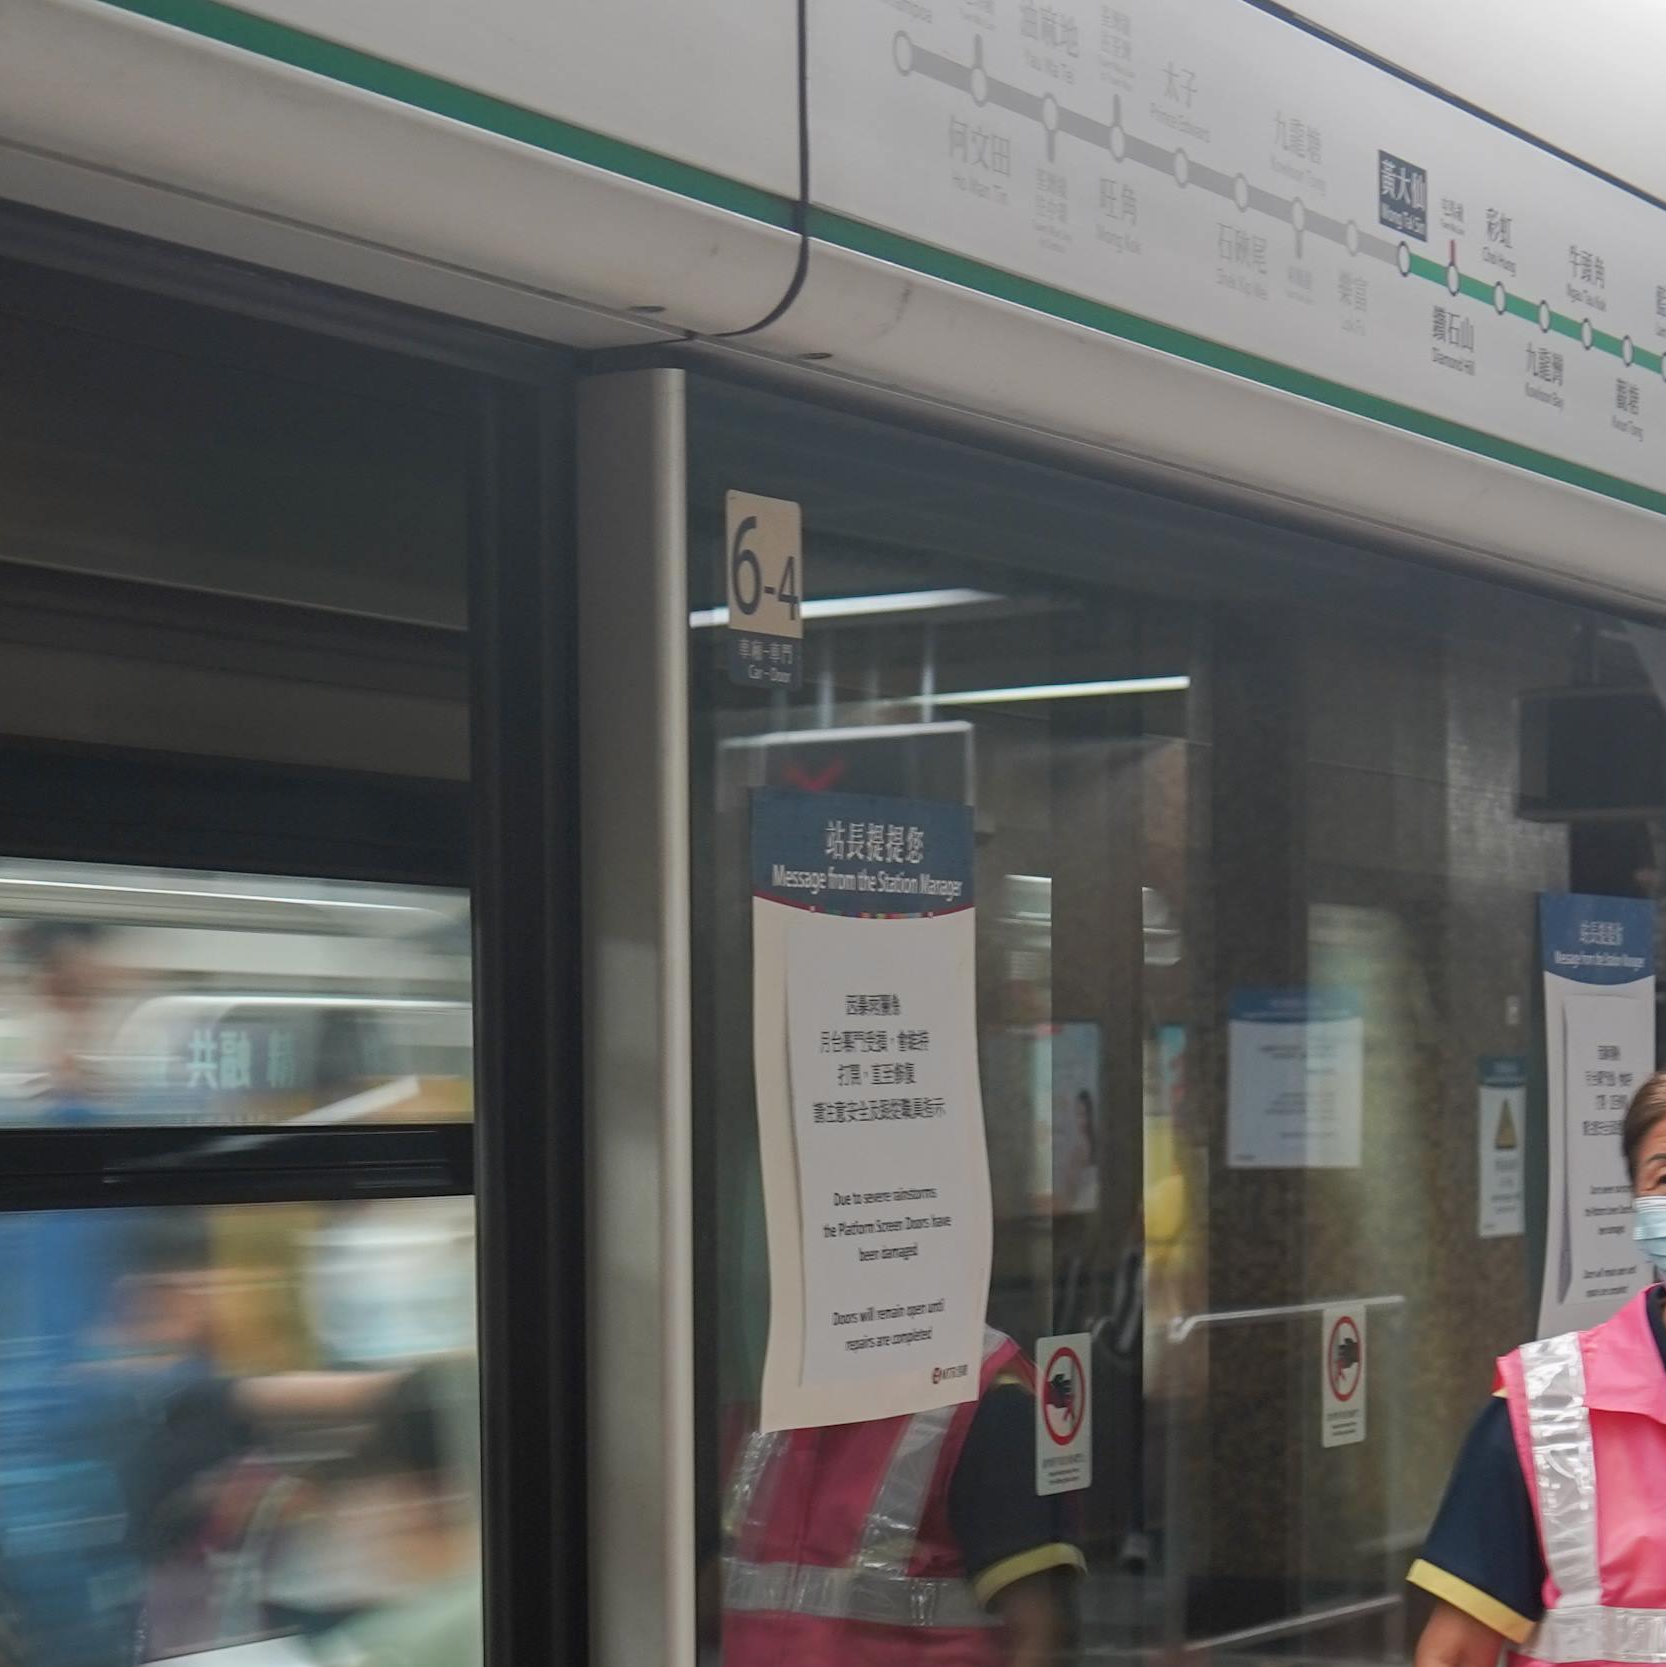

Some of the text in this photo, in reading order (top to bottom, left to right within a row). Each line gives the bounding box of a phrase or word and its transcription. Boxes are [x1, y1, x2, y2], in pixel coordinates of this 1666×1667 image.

[1162, 61, 1197, 108] 太子
[949, 114, 1011, 178] 何文田
[1100, 176, 1137, 226] 旺角
[1380, 158, 1426, 210] 黃大仙
[1486, 206, 1513, 250] 彩虹
[732, 515, 799, 621] 6-4
[824, 820, 925, 864] 站長提提您
[772, 864, 964, 901] Message from the Station Manager
[833, 1186, 937, 1208] Due to severe rainstorms
[822, 1213, 951, 1239] the Platform Screen Doors have
[859, 1243, 918, 1263] been damaged
[832, 1298, 945, 1328] Doors will remain open until
[845, 1327, 932, 1354] repairs are completed
